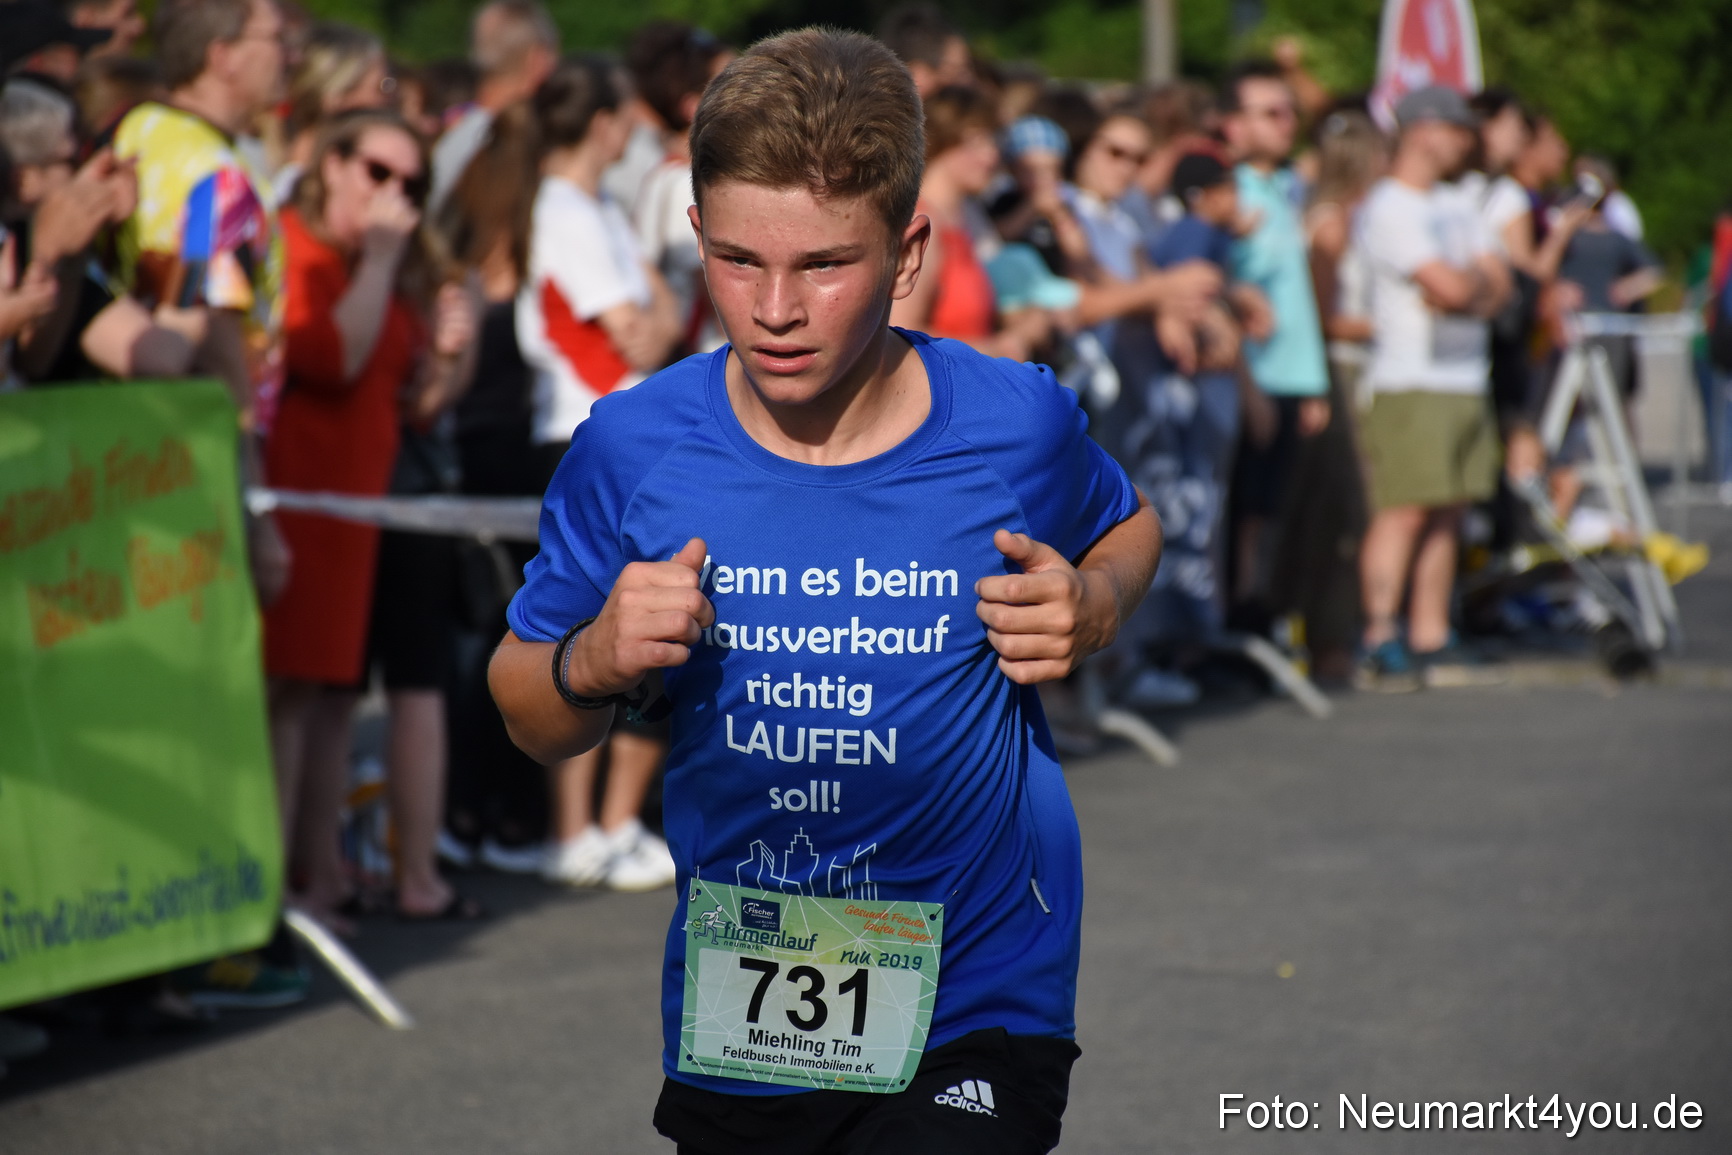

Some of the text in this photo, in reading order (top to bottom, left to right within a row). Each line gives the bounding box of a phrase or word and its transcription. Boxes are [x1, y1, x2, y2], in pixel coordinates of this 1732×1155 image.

[800, 567, 841, 596] es
[855, 557, 959, 597] beim
[746, 672, 873, 717] richtig
[726, 714, 897, 765] LAUFEN
[768, 779, 841, 814] soll!
[748, 905, 775, 917] Fischer
[844, 904, 926, 929] Gesunde Firmen
[723, 940, 764, 952] neumarkt
[724, 920, 819, 951] firmenlauf
[863, 919, 935, 946] laufen länger!
[840, 950, 923, 971] run 2019
[739, 956, 869, 1037] 731
[748, 1028, 862, 1058] Miehling Tim
[722, 1045, 876, 1075] Feldbusch Immobilien e.K.
[934, 1094, 999, 1118] adid
